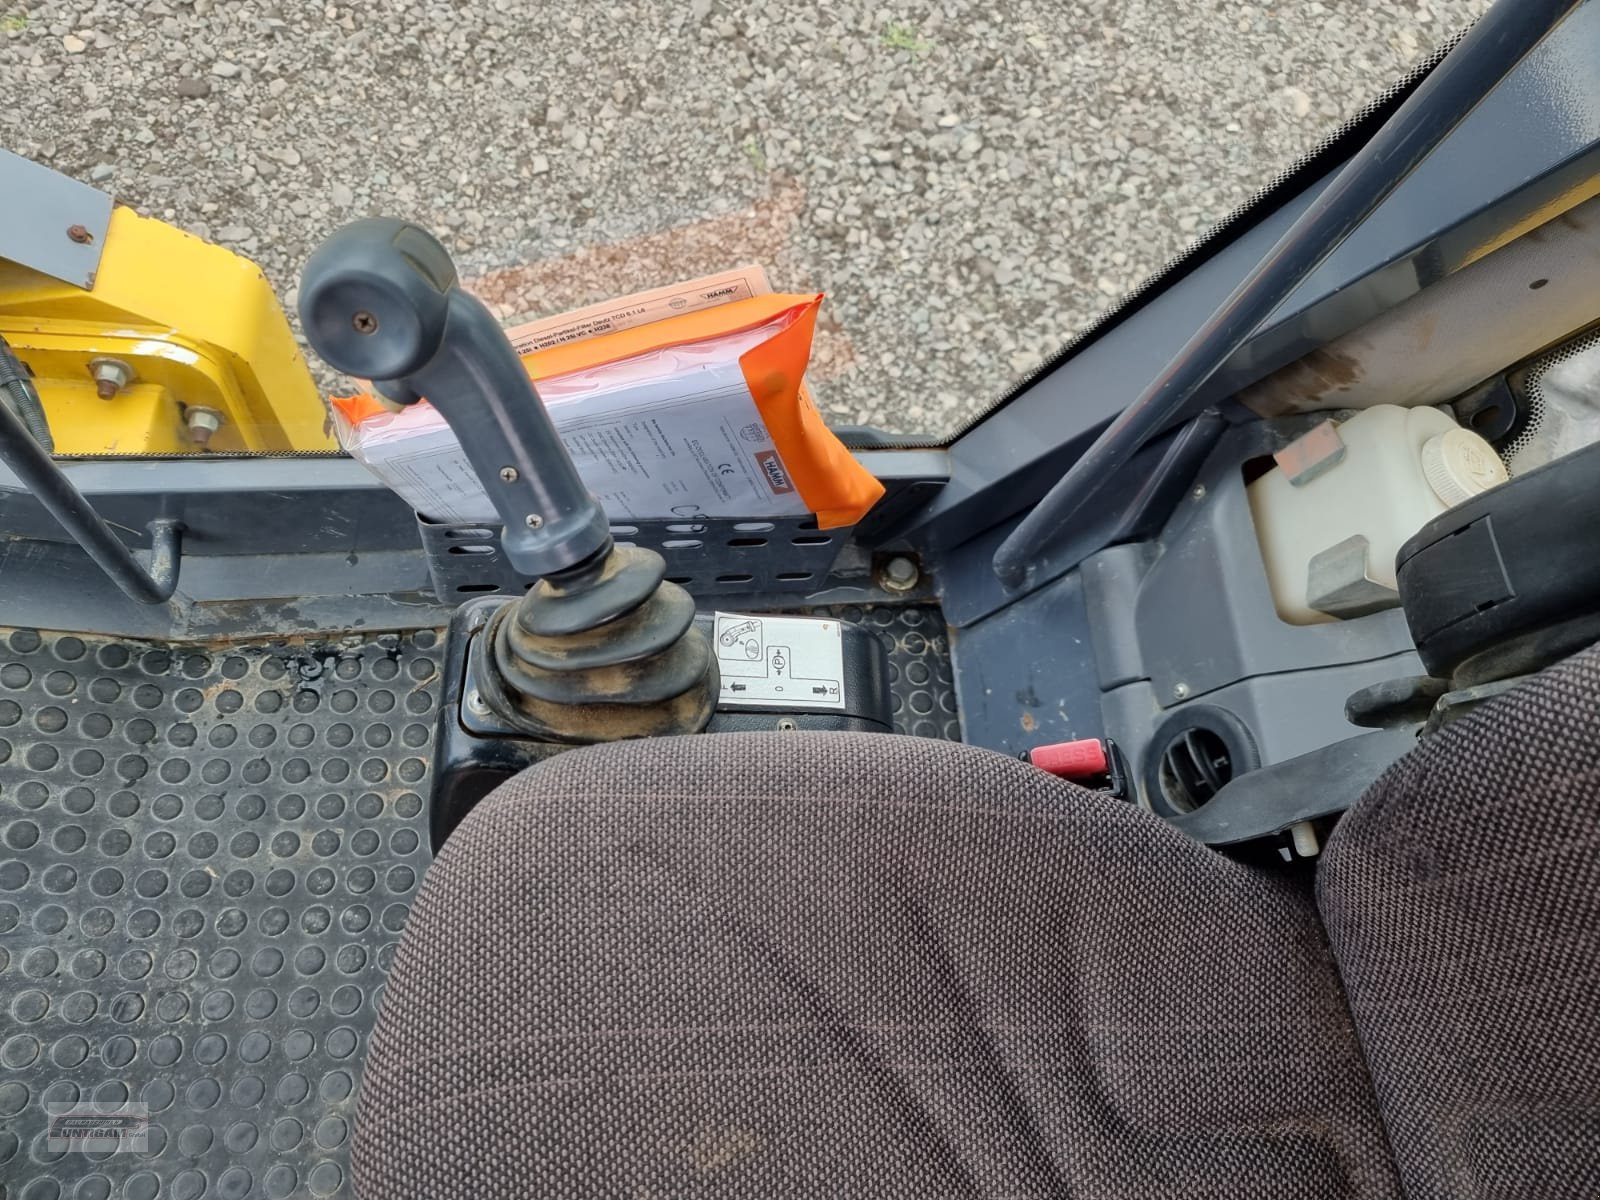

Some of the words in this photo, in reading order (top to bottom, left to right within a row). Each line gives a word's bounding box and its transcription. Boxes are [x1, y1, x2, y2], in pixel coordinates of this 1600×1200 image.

[707, 287, 734, 299] HAMM
[611, 313, 626, 322] TCD
[764, 460, 786, 487] HAMM
